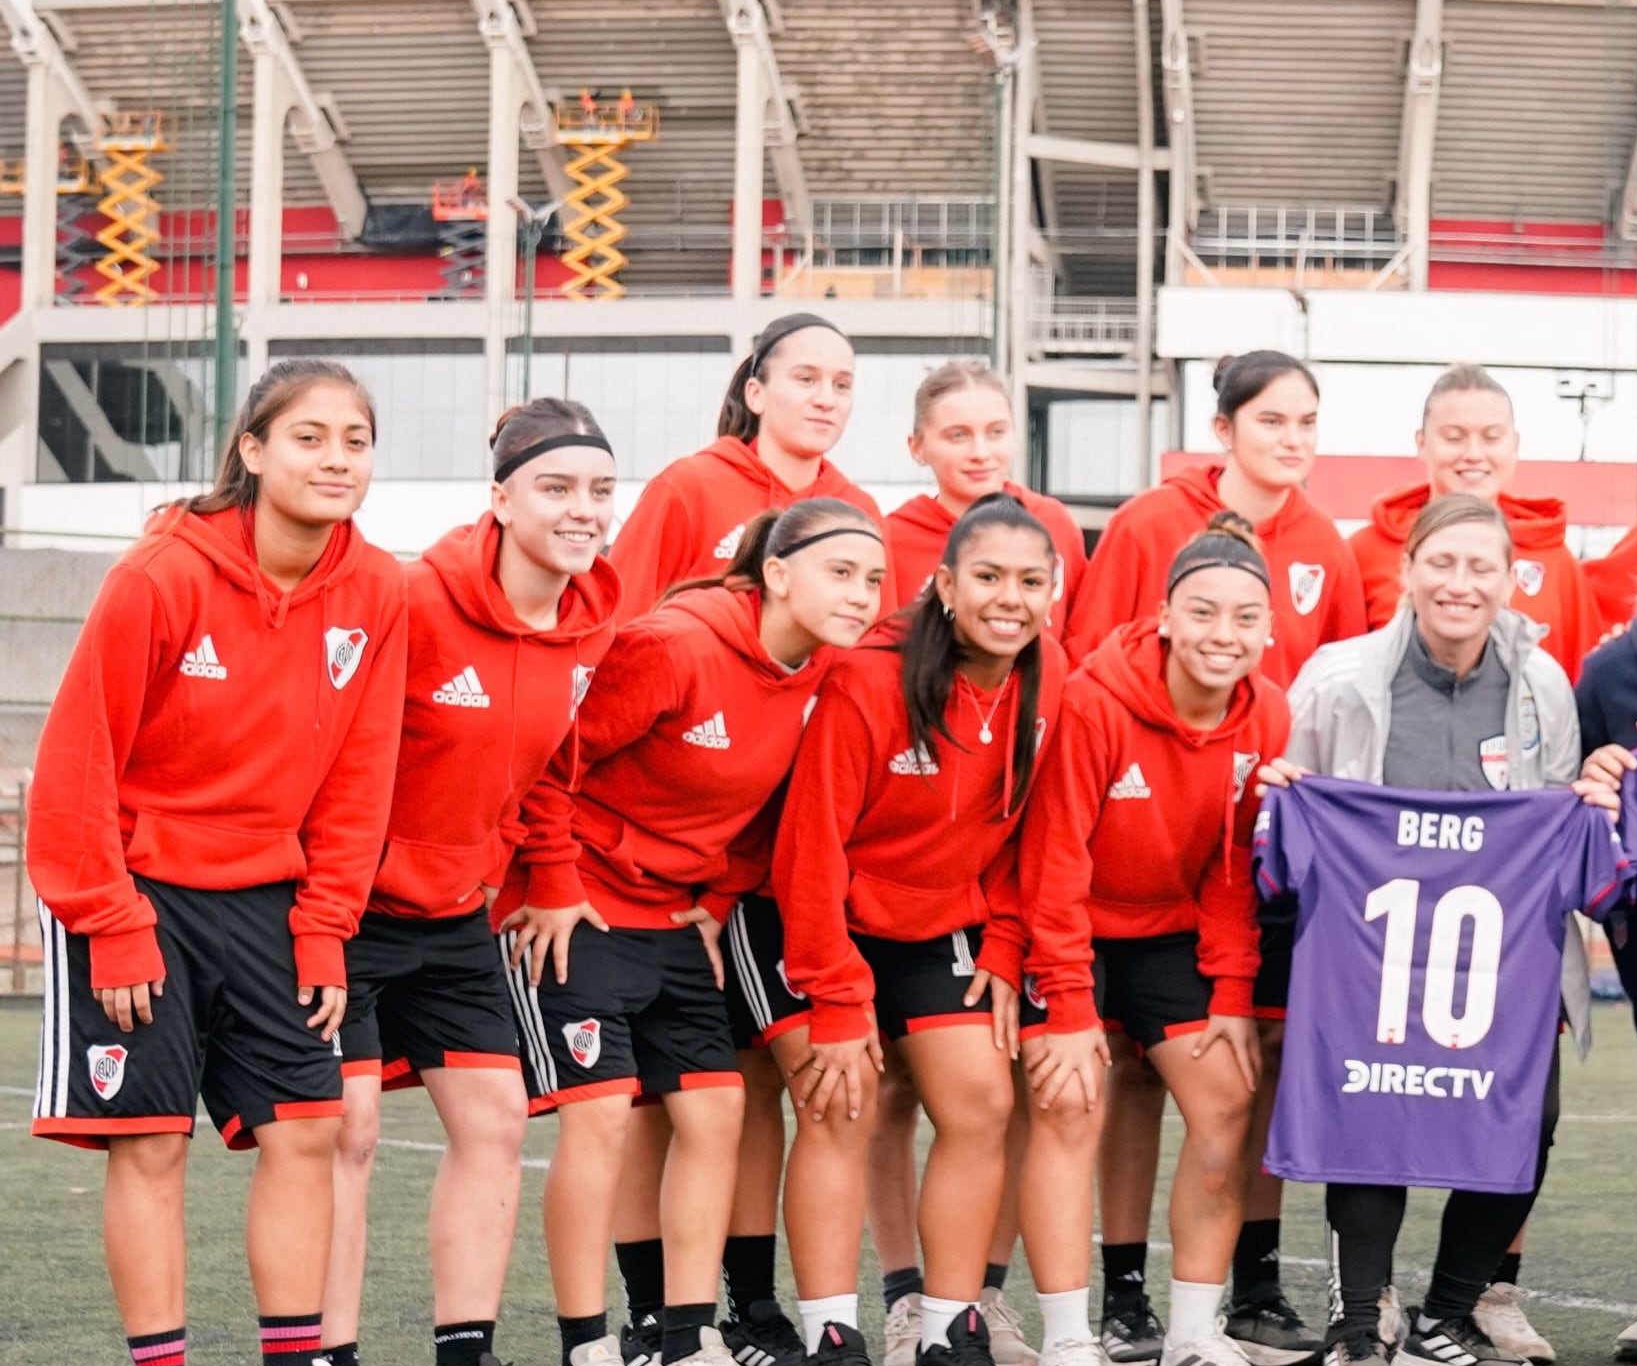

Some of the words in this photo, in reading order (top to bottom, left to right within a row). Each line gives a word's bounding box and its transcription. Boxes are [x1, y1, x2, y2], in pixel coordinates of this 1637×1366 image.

[433, 691, 490, 708] adidas
[682, 731, 731, 750] adidas
[1397, 810, 1485, 852] BERG
[1364, 878, 1504, 1049] 10
[1341, 1059, 1495, 1100] DIRECTV
